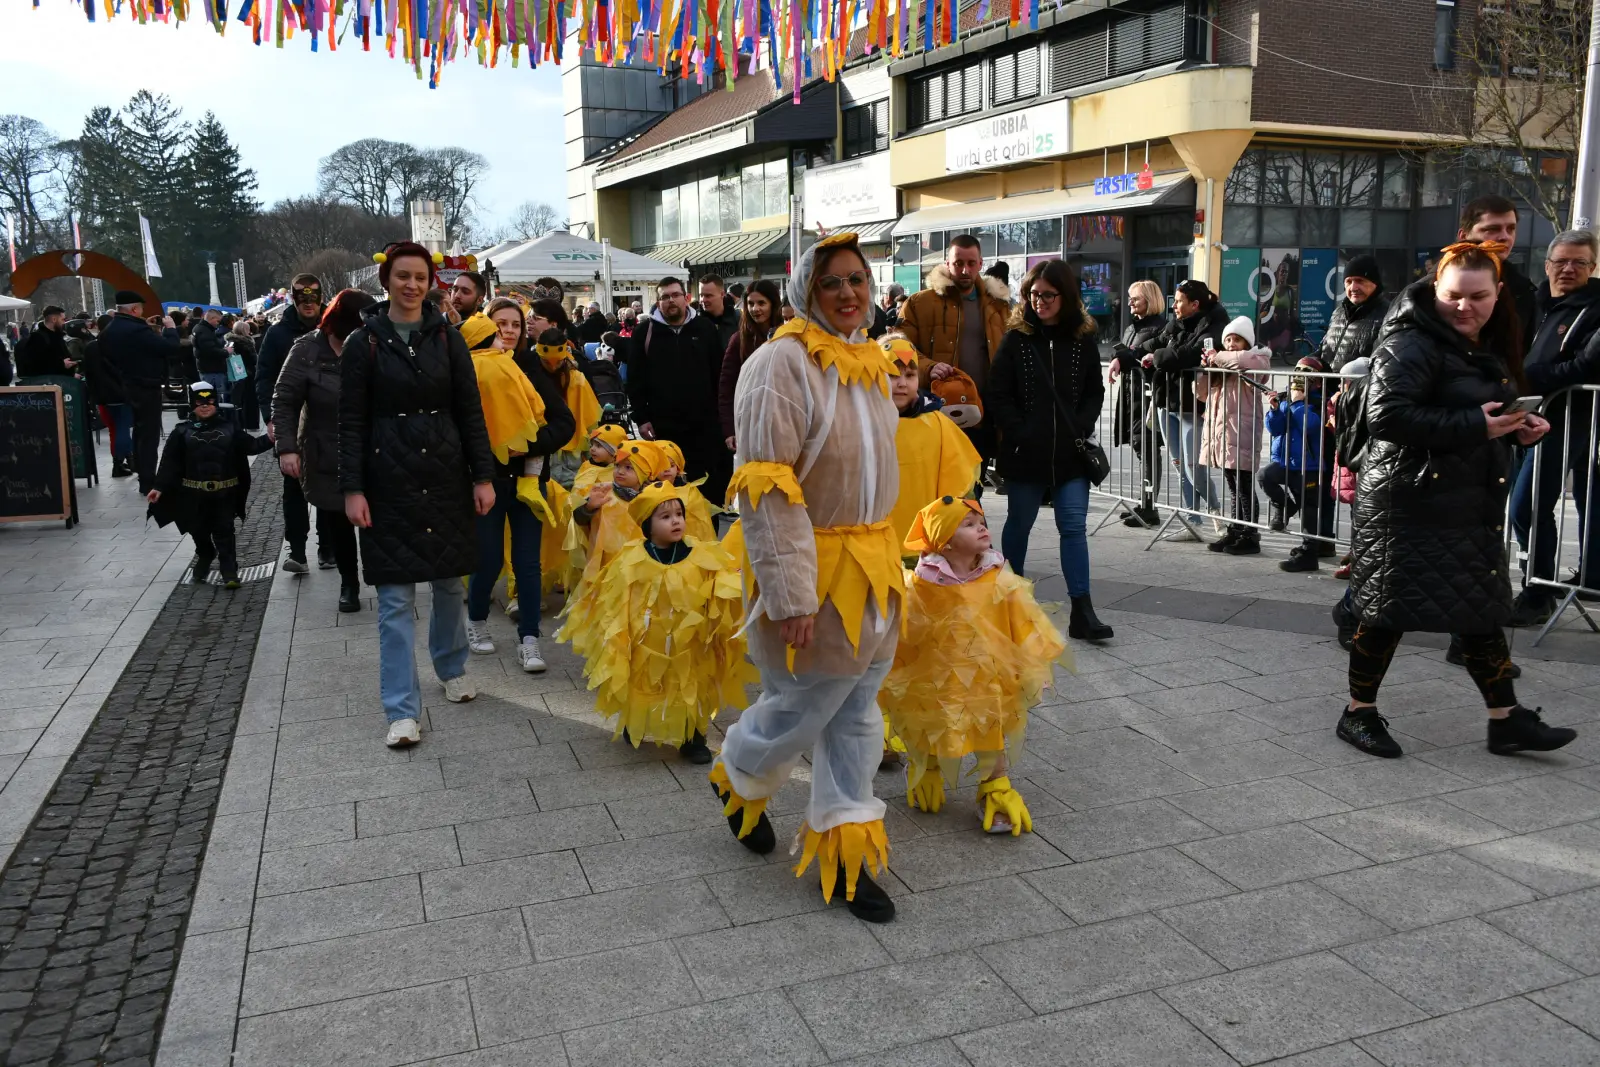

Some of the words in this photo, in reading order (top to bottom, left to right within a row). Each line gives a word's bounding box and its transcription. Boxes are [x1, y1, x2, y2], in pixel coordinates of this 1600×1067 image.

[992, 113, 1029, 137] URBIA
[956, 147, 980, 168] urbi
[984, 145, 998, 163] et
[1002, 136, 1030, 159] orbi
[1035, 133, 1054, 154] 25
[1094, 172, 1137, 196] ERSTE
